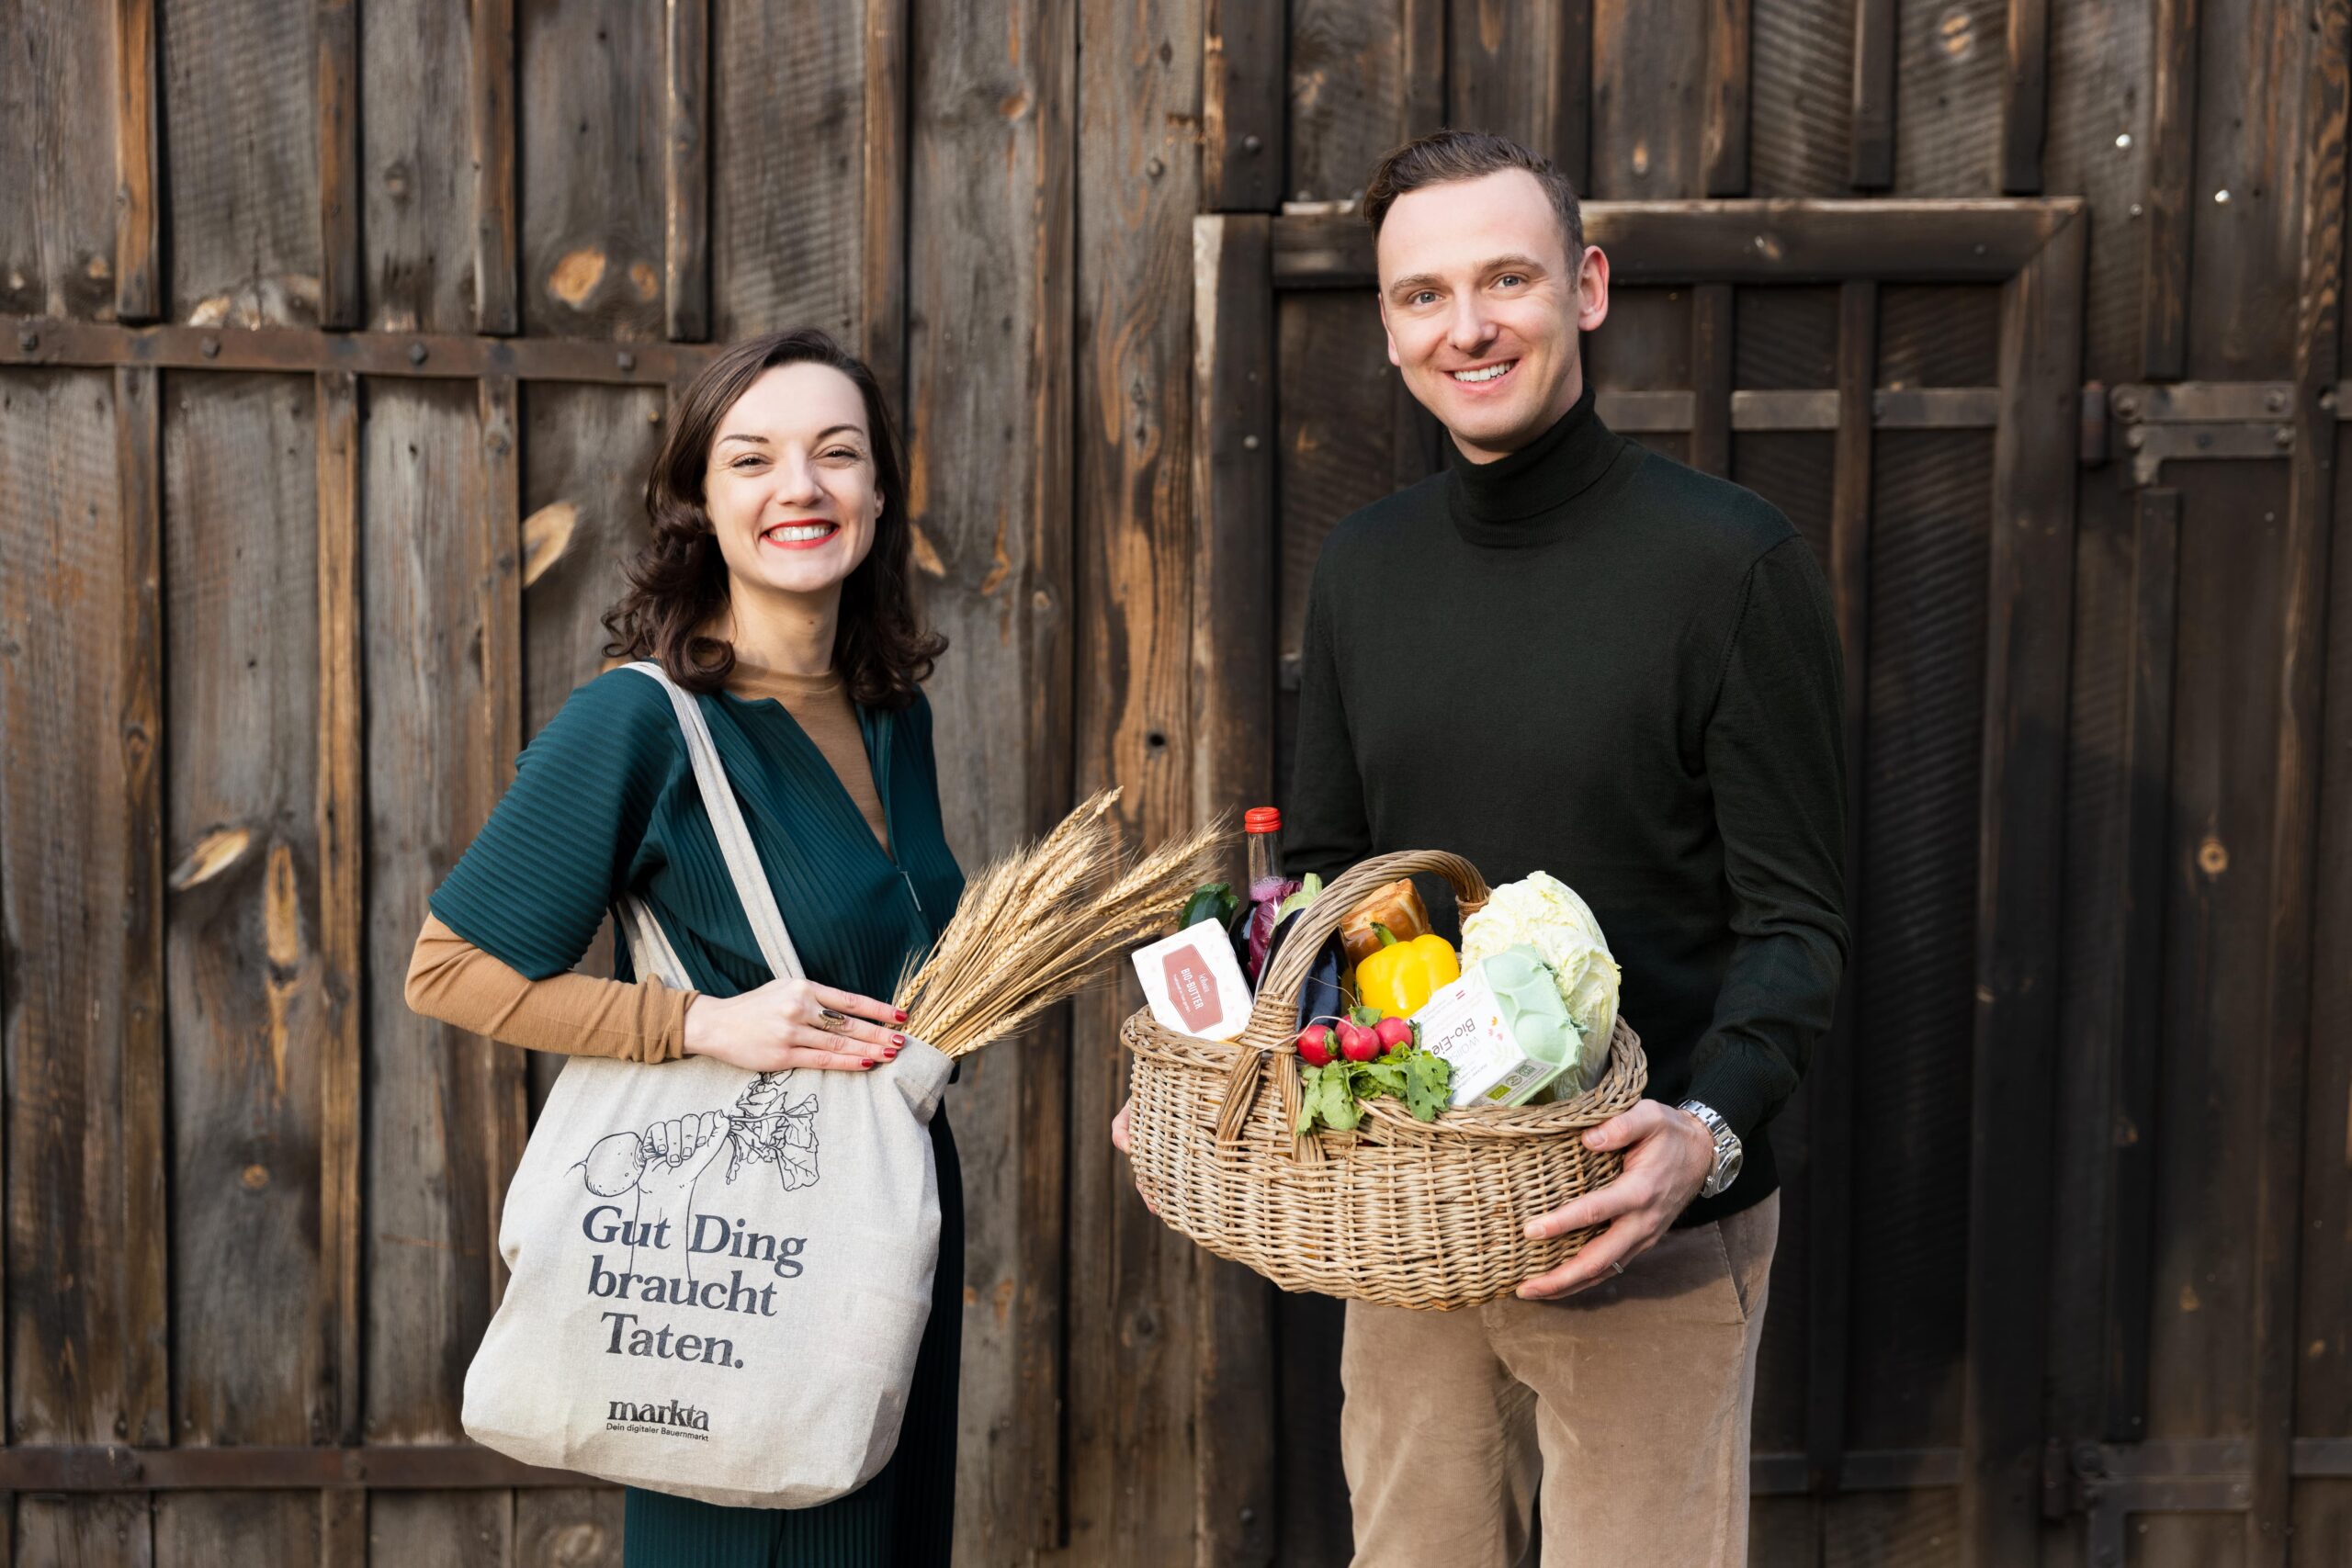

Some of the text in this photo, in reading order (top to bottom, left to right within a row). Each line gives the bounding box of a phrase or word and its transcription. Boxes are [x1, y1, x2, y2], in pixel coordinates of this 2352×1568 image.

[1181, 967, 1204, 1010] BIO-BUTTER
[1431, 1018, 1476, 1056] Bio-Eie
[582, 1205, 808, 1279] Gut Ding
[588, 1254, 778, 1317] braucht
[600, 1311, 744, 1370] Taten.
[606, 1399, 710, 1432] markta
[606, 1423, 709, 1442] Dein digitaler Bauernmarkt
